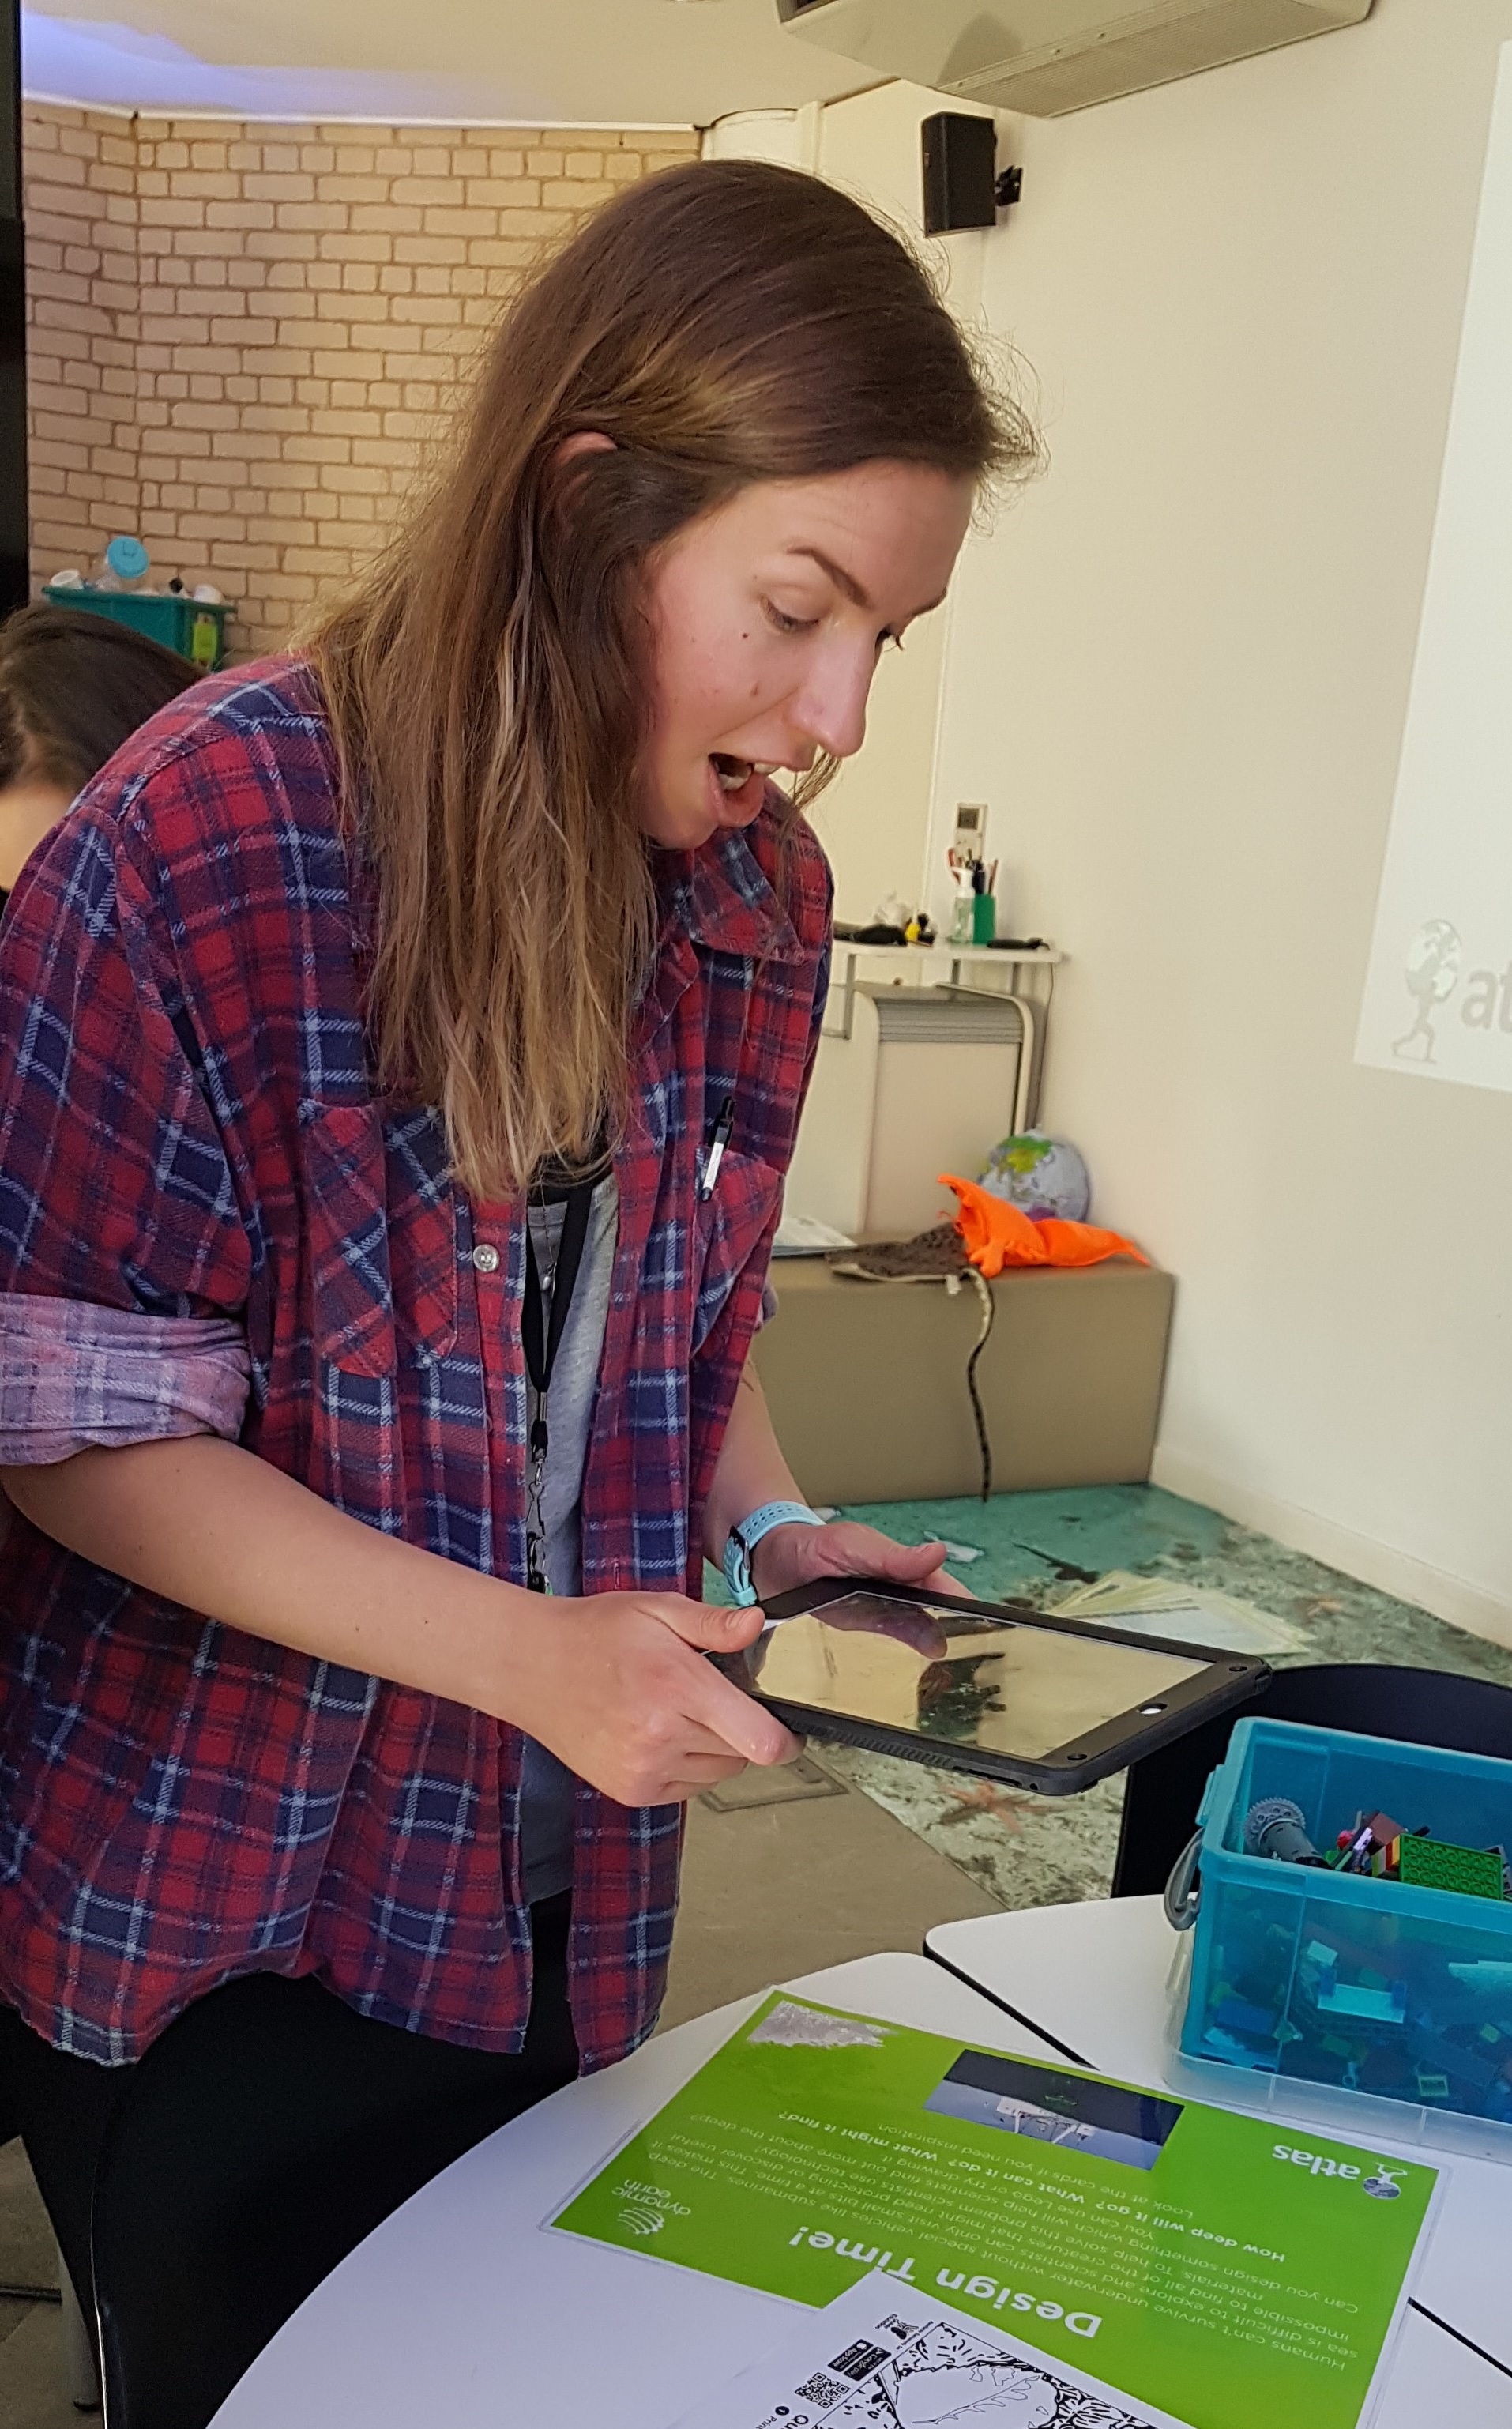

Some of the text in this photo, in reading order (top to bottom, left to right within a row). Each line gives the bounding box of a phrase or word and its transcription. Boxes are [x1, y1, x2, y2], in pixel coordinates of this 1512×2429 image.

[740, 2127, 765, 2139] the
[671, 2134, 717, 2152] useful
[769, 2135, 814, 2151] about
[648, 2152, 687, 2168] deep
[667, 2145, 715, 2164] makes
[720, 2149, 784, 2171] discover
[817, 2149, 857, 2164] more
[961, 2147, 1001, 2161] need
[718, 2160, 747, 2175] This
[860, 2161, 887, 2173] out
[1005, 2158, 1032, 2171] you
[1272, 2145, 1361, 2180] atlas
[690, 2166, 717, 2179] The
[849, 2173, 877, 2185] use
[889, 2170, 920, 2184] find
[1053, 2172, 1096, 2189] cards
[623, 2179, 671, 2198] earth
[778, 2112, 1285, 2262] How deep will it go? What can it do? What might it find?
[808, 2173, 890, 2201] protecting
[965, 2177, 986, 2189] try
[881, 2182, 953, 2207] scientists
[926, 2179, 998, 2204] scientists
[1012, 2190, 1053, 2209] Lego
[1100, 2186, 1126, 2199] the
[1132, 2195, 1149, 2204] at
[611, 2186, 691, 2216] dynamic
[829, 2193, 859, 2207] bits
[893, 2198, 934, 2214] need
[820, 2204, 847, 2217] like
[861, 2202, 904, 2218] small
[958, 2204, 1027, 2228] problem
[1003, 2201, 1038, 2217] help
[1057, 2205, 1085, 2217] use
[1153, 2201, 1194, 2219] Look
[852, 2212, 913, 2235] vehicles
[908, 2215, 940, 2229] visit
[938, 2211, 986, 2229] might
[1041, 2213, 1069, 2226] will
[1090, 2215, 1119, 2228] can
[945, 2226, 981, 2240] only
[991, 2226, 1023, 2242] that
[1031, 2225, 1059, 2240] this
[1074, 2223, 1123, 2242] which
[1124, 2224, 1153, 2240] You
[918, 2232, 976, 2254] special
[985, 2238, 1015, 2251] can
[1065, 2236, 1107, 2253] solve
[788, 2226, 916, 2281] Time!
[1029, 2238, 1105, 2265] creatures
[1113, 2250, 1149, 2268] help
[1128, 2239, 1217, 2271] something
[981, 2250, 1044, 2275] without
[1021, 2249, 1096, 2277] scientists
[1111, 2263, 1138, 2277] the
[1154, 2263, 1172, 2276] To
[1101, 2274, 1135, 2288] and
[1142, 2274, 1160, 2283] of
[1164, 2280, 1186, 2291] all
[1223, 2268, 1281, 2289] design
[1050, 2273, 1149, 2307] underwater
[1189, 2288, 1224, 2304] find
[1286, 2286, 1319, 2300] you
[935, 2267, 1103, 2339] Design
[1139, 2288, 1204, 2310] explore
[1229, 2300, 1247, 2311] to
[1324, 2297, 1359, 2314] Can
[1154, 2304, 1215, 2329] survive
[1209, 2308, 1228, 2320] to
[1234, 2315, 1302, 2341] difficult
[1253, 2307, 1348, 2341] impossible
[1223, 2325, 1266, 2344] can't
[1308, 2337, 1322, 2347] is
[1272, 2341, 1345, 2370] Humans
[1327, 2344, 1357, 2358] sea
